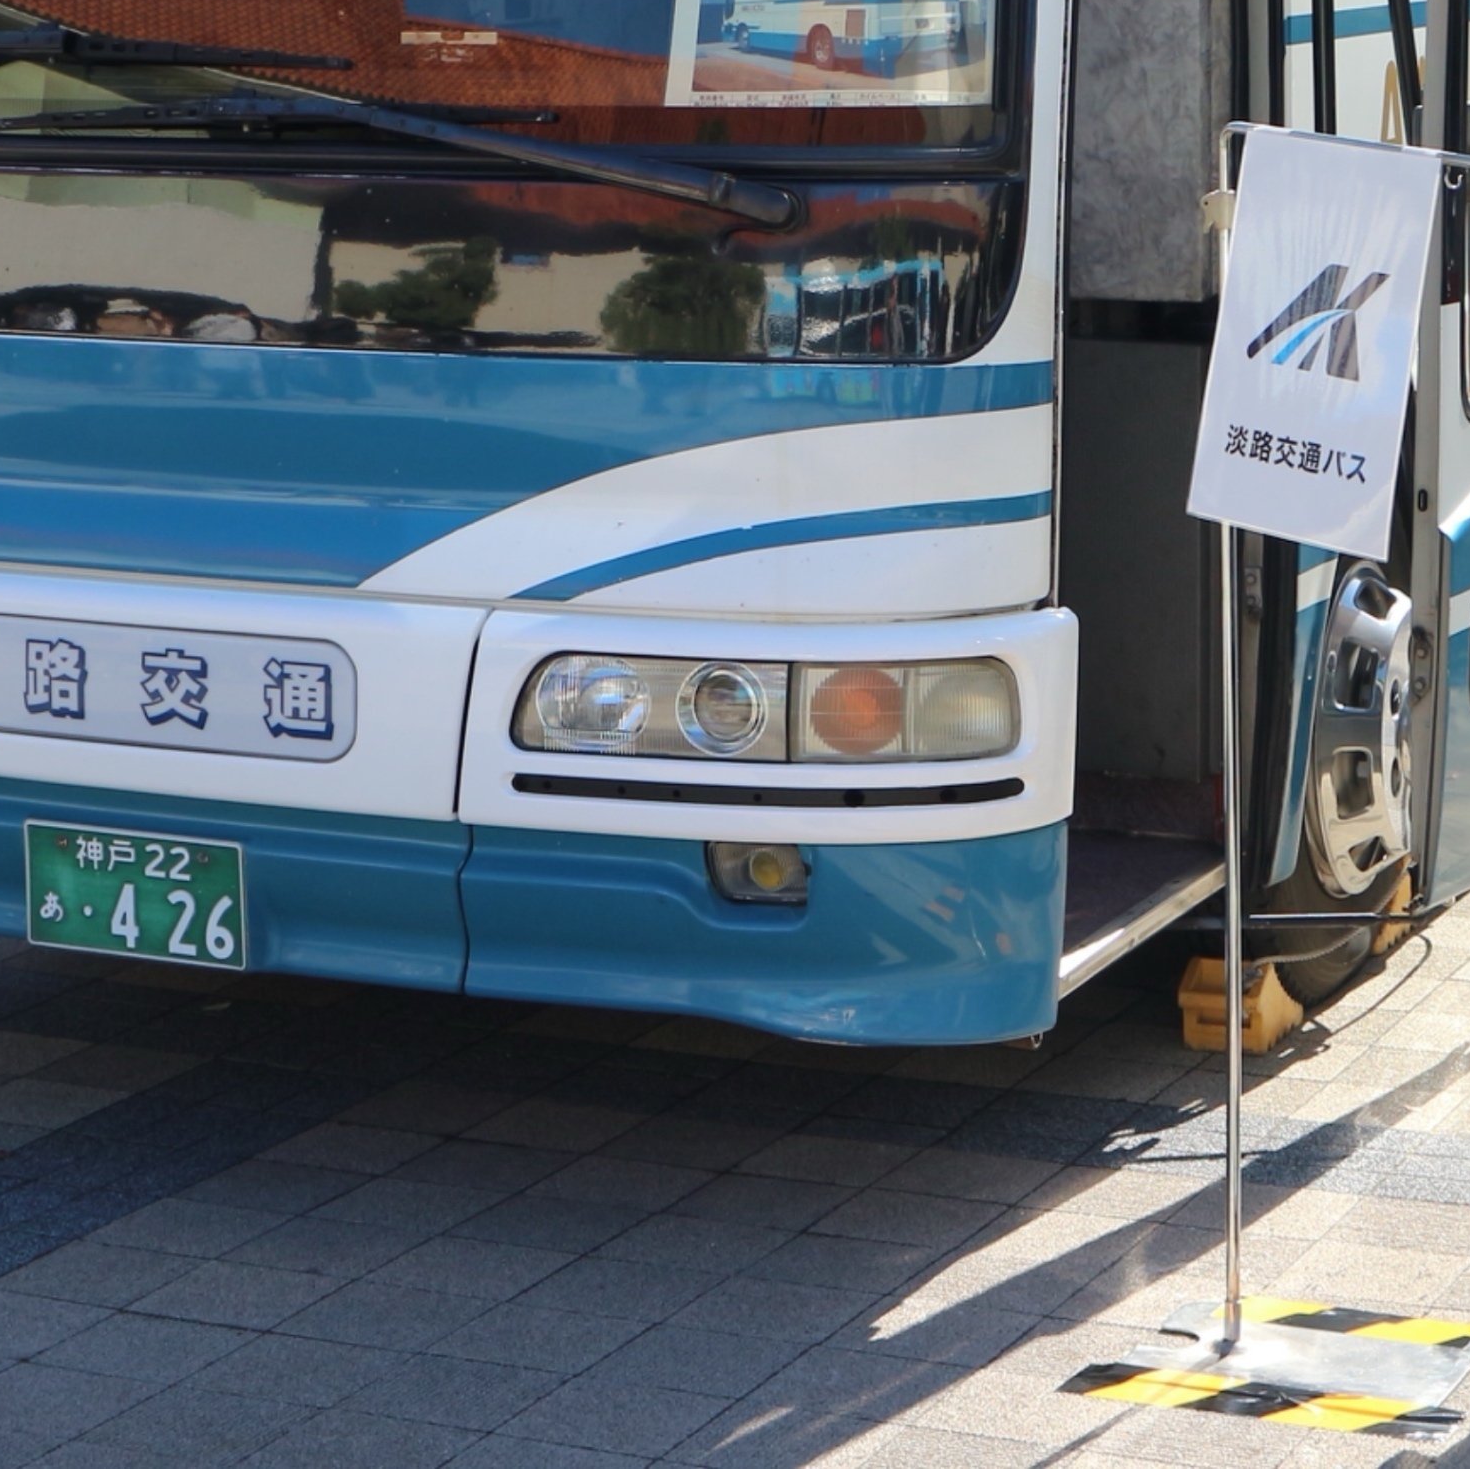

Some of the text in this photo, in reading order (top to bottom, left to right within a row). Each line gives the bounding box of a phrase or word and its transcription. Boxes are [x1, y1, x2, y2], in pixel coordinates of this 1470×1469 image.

[1224, 423, 1367, 485] 淡路交通バス
[40, 891, 64, 923] あ
